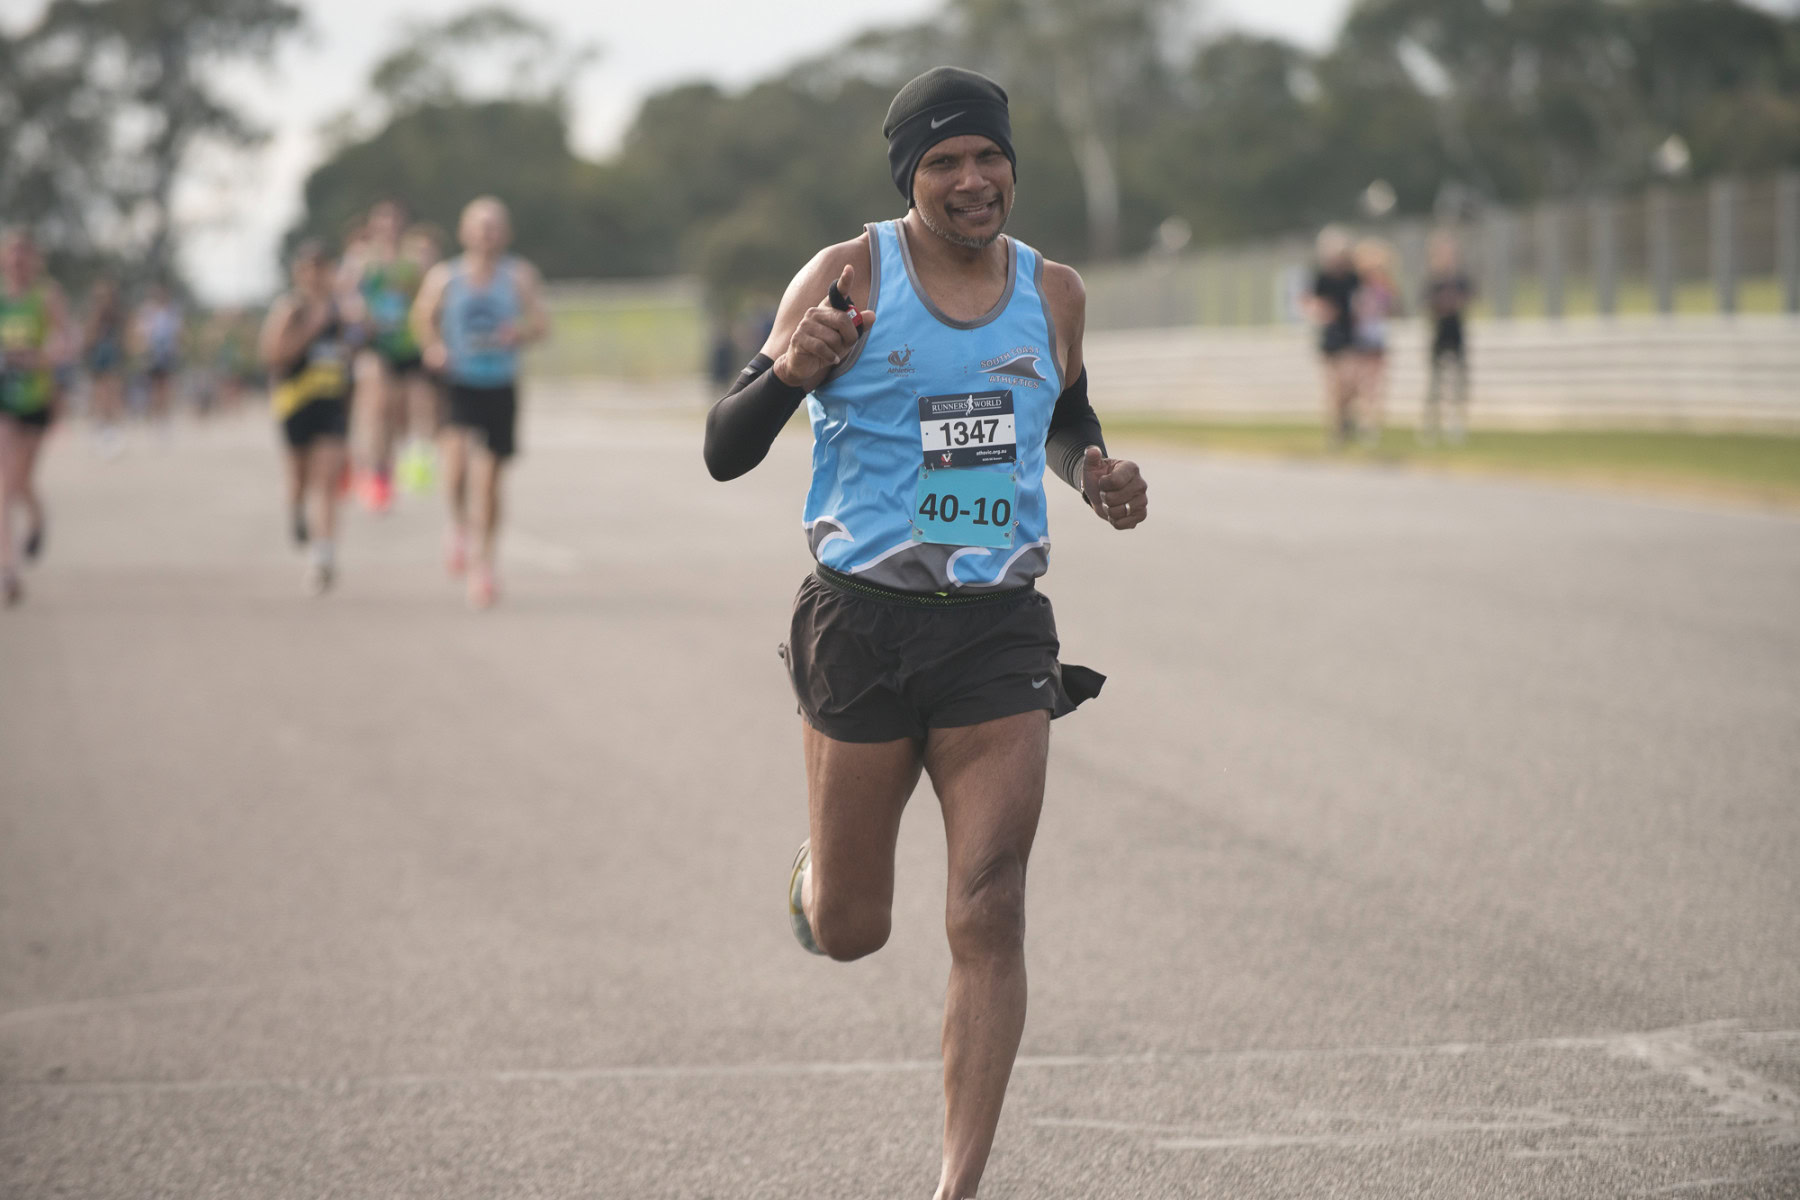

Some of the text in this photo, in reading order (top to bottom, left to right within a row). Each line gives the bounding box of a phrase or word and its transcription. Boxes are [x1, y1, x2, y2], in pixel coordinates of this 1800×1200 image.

[980, 346, 1040, 368] SOUTH COAST
[989, 375, 1039, 389] ATHLETICS
[932, 399, 1002, 412] RUNNERS WORLD
[940, 419, 999, 446] 1347
[919, 493, 1011, 527] 40-10
